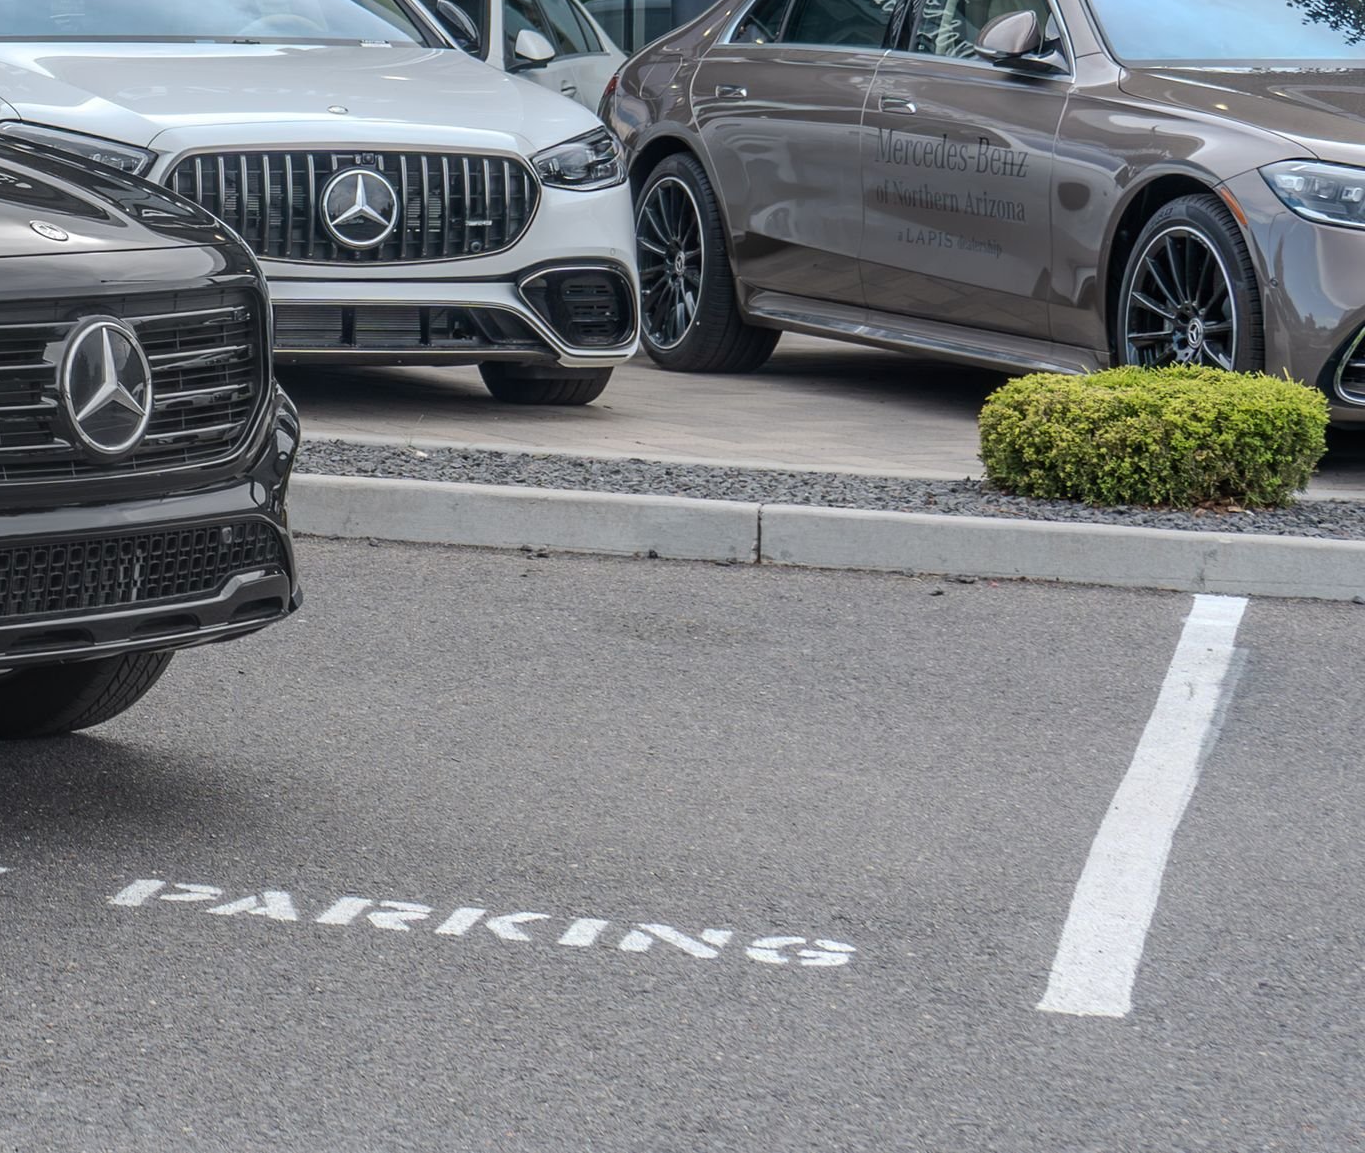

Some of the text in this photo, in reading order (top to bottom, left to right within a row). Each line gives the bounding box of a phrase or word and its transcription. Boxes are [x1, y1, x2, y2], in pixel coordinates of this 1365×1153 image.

[874, 127, 1029, 178] Mercedes-Benz
[876, 179, 1026, 222] of Northern Arizona
[906, 228, 953, 249] LAPIS
[107, 878, 859, 968] PARKING
